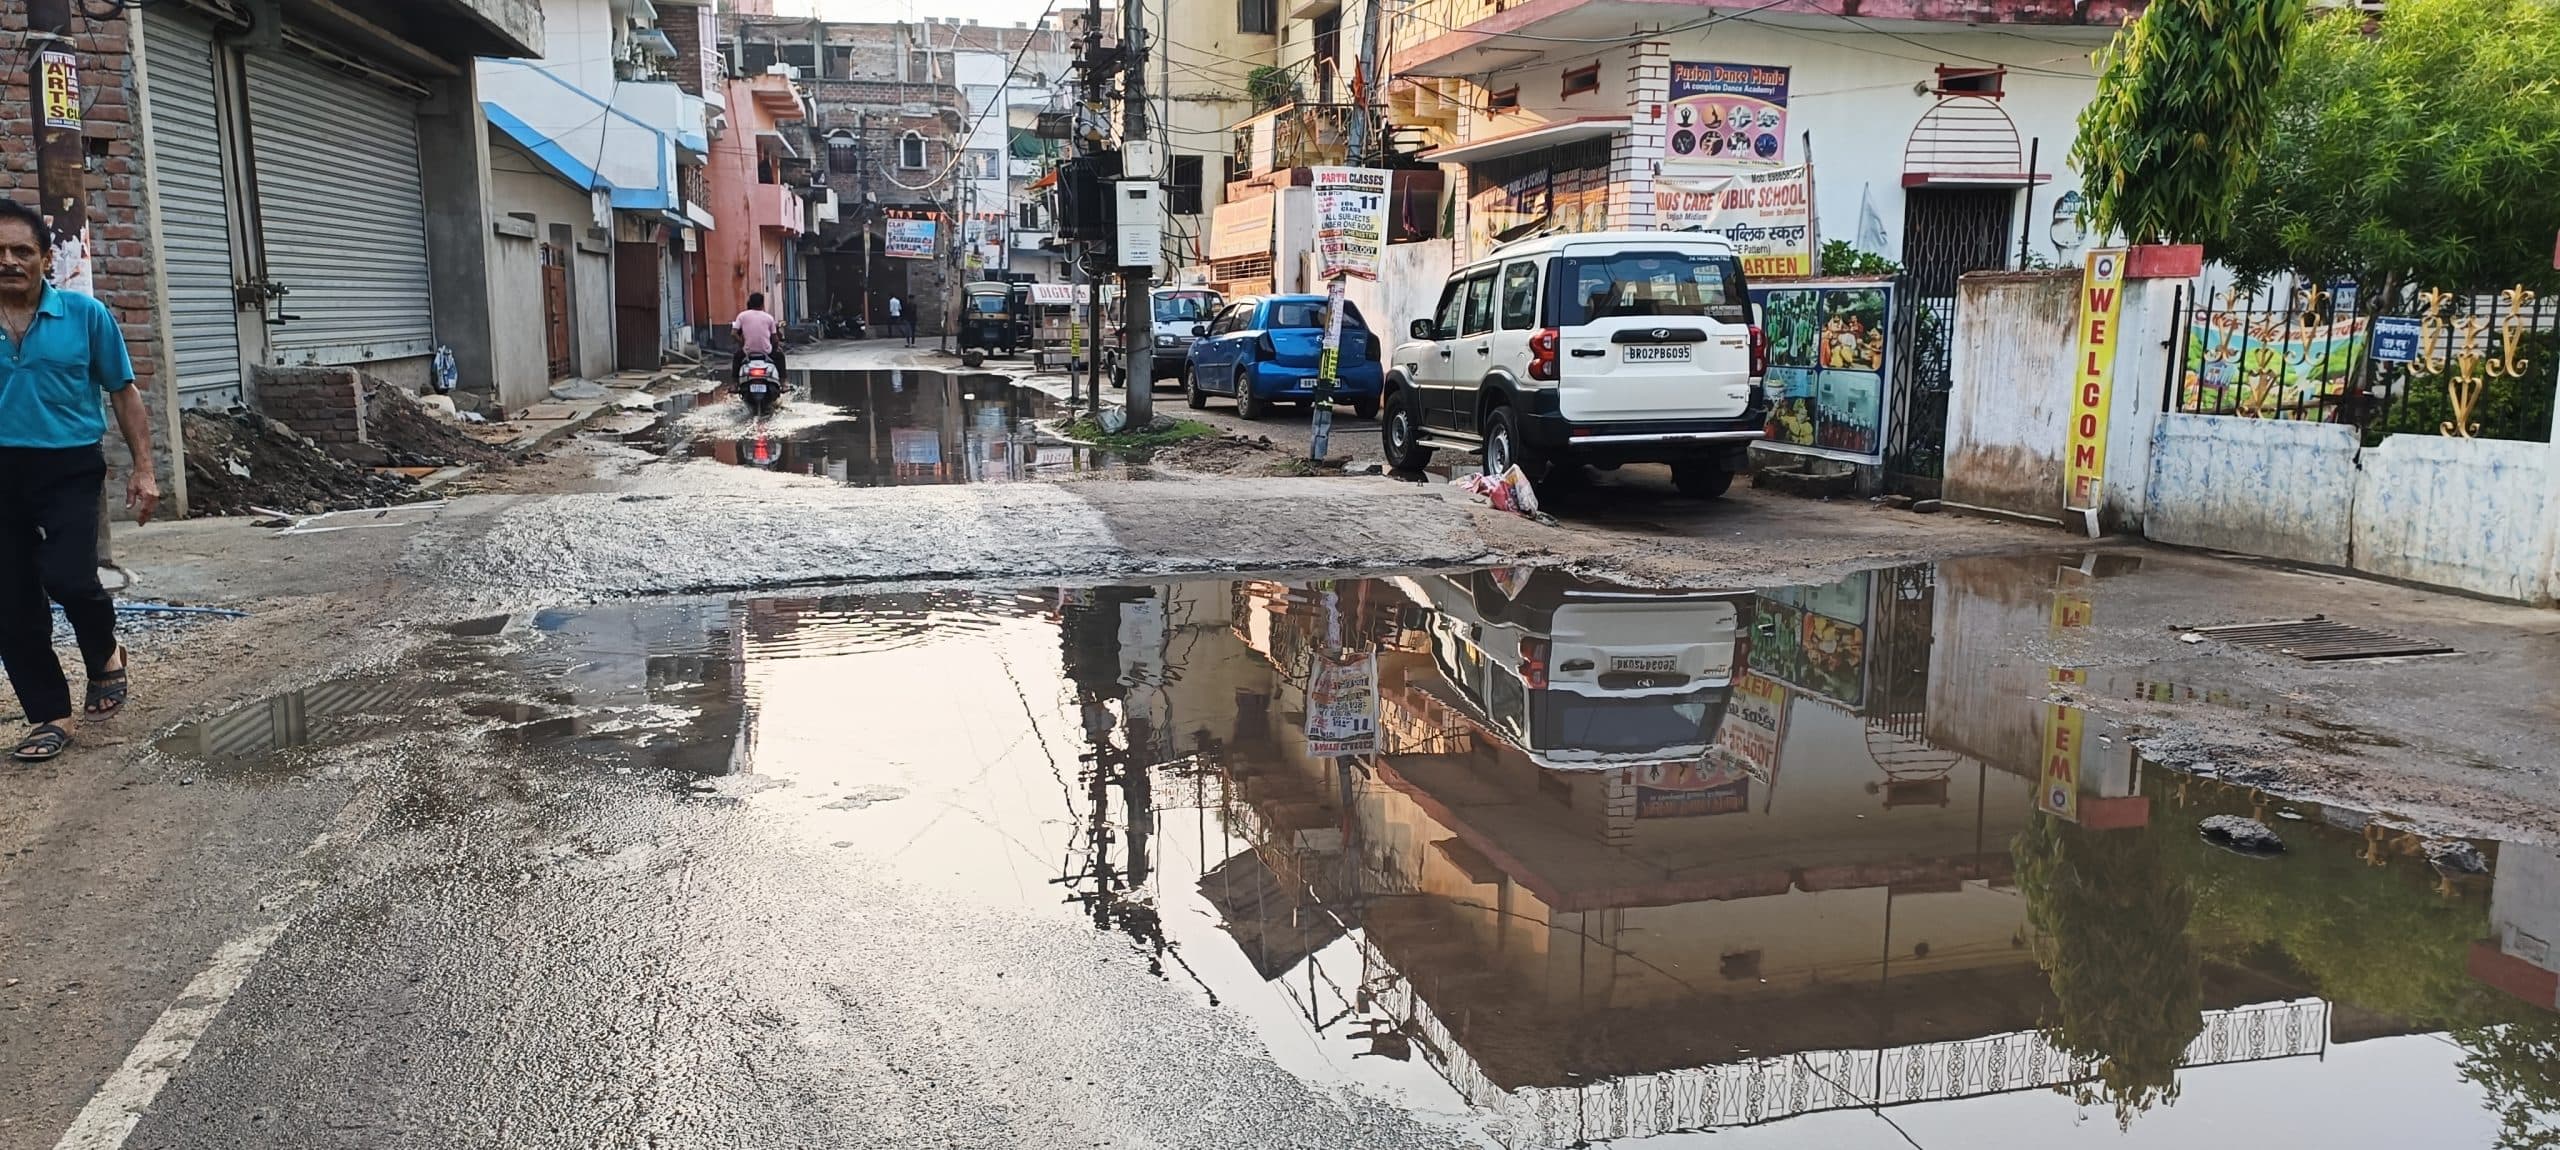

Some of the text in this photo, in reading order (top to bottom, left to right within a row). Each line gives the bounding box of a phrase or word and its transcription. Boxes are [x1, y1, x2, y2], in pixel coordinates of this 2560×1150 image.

[1675, 63, 1785, 86] Fusion Dance Mania
[48, 63, 65, 118] ARTS
[1691, 82, 1721, 92] complete
[1723, 83, 1742, 92] Dance
[1321, 173, 1384, 186] PARTH CLASSES
[1656, 191, 1680, 211] KIDS
[1683, 192, 1715, 211] CARE
[1758, 184, 1806, 207] SCHOOL
[1326, 213, 1370, 223] ALL SUBJECTS
[1321, 221, 1375, 231] UNDER ONE ROOF
[1344, 229, 1378, 240] CHEMISTRY
[1768, 225, 1806, 246] स्कूल
[1744, 257, 1797, 275] ARTEN
[1039, 287, 1072, 299] DIGIT
[1629, 347, 1690, 360] BR02PB6095
[2074, 287, 2115, 499] WELCOME
